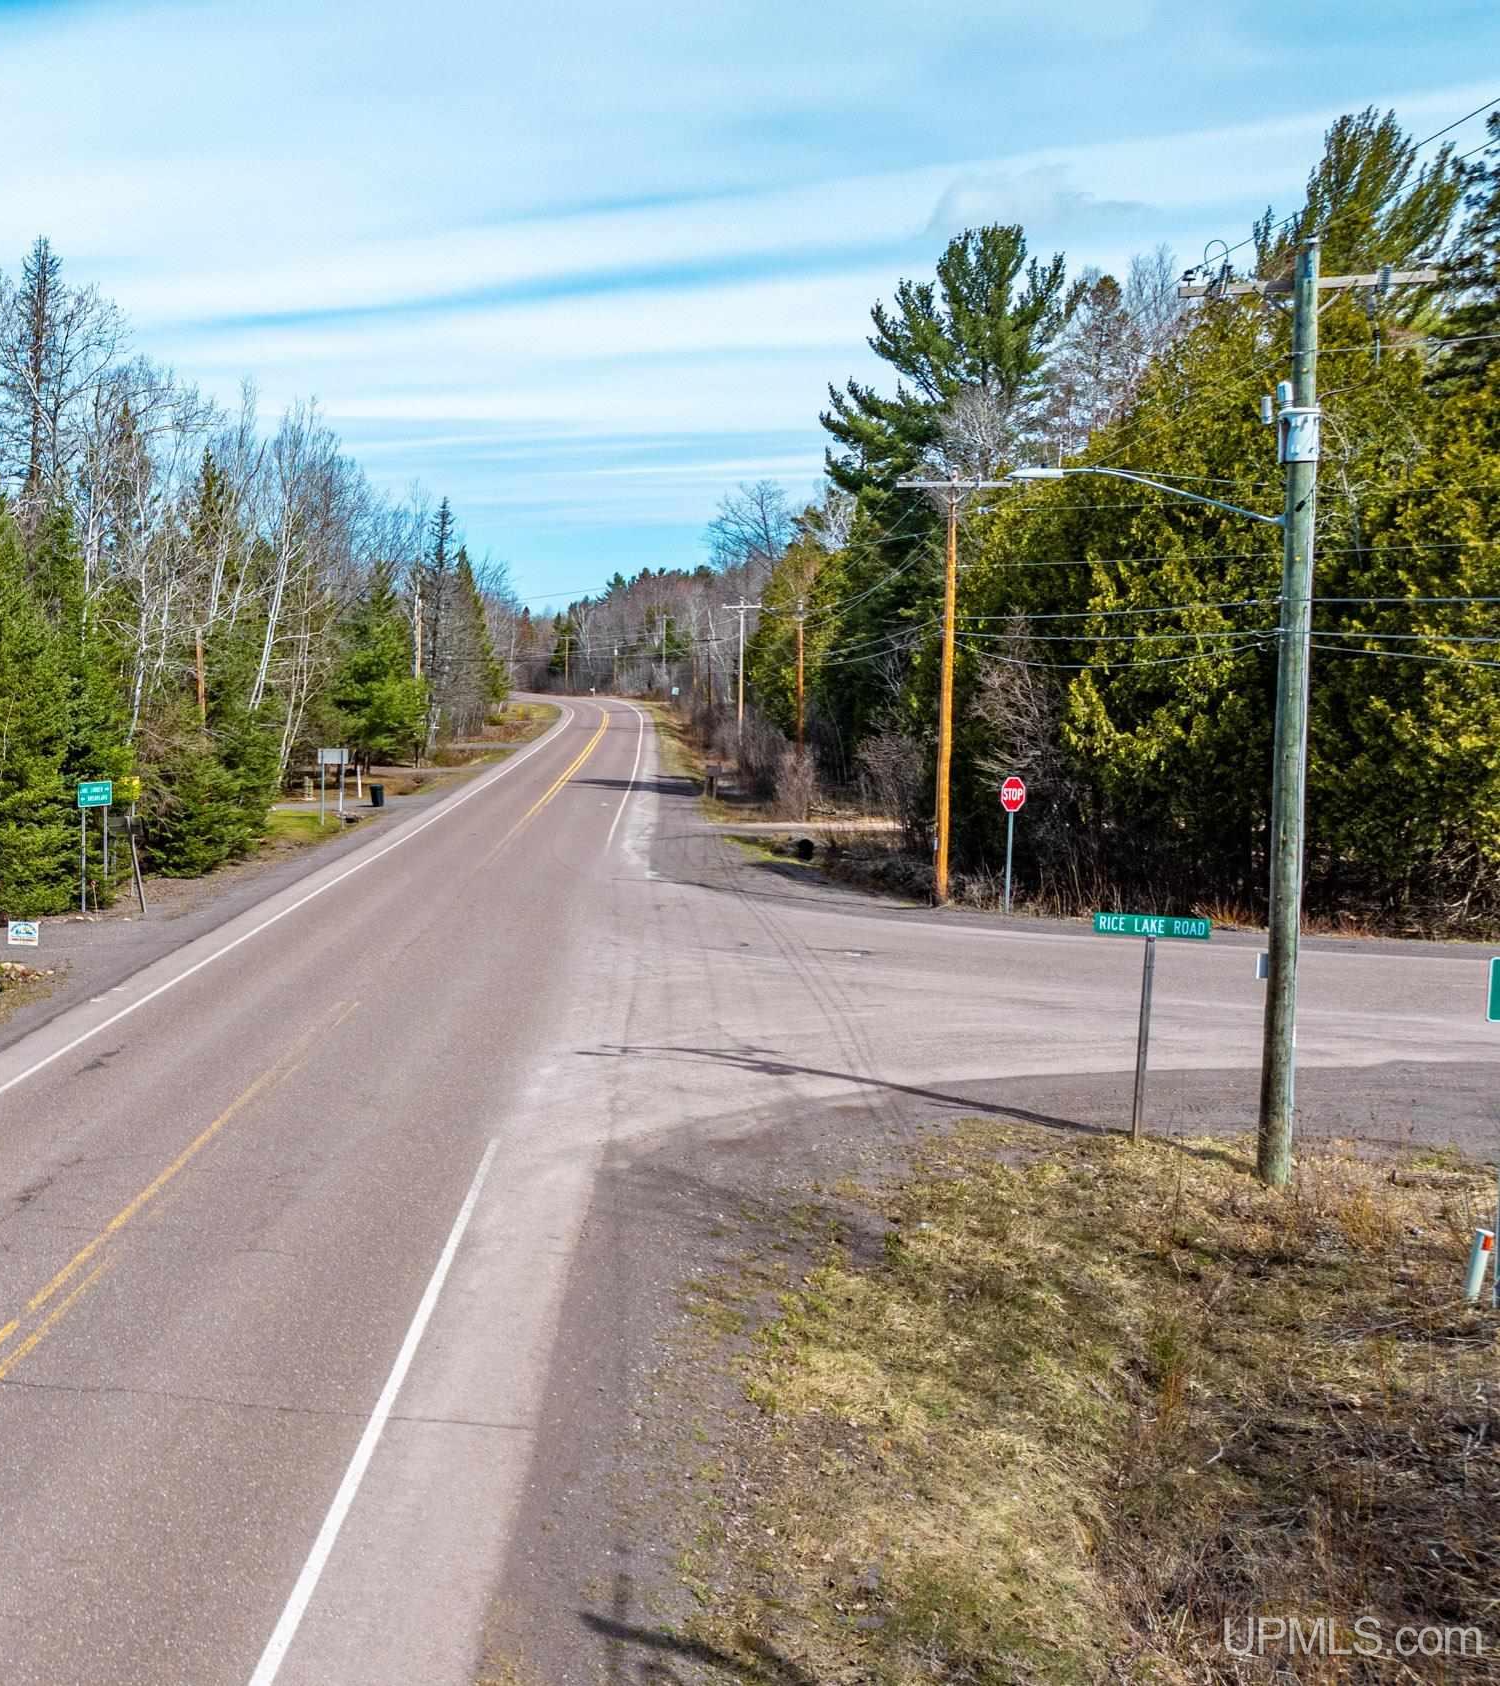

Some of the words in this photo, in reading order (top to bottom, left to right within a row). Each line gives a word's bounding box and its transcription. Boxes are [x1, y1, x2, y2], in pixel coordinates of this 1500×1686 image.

[1003, 788, 1023, 800] STOP
[1099, 916, 1125, 932] RICE
[1134, 918, 1165, 934] LAKE
[1174, 920, 1205, 936] ROAD
